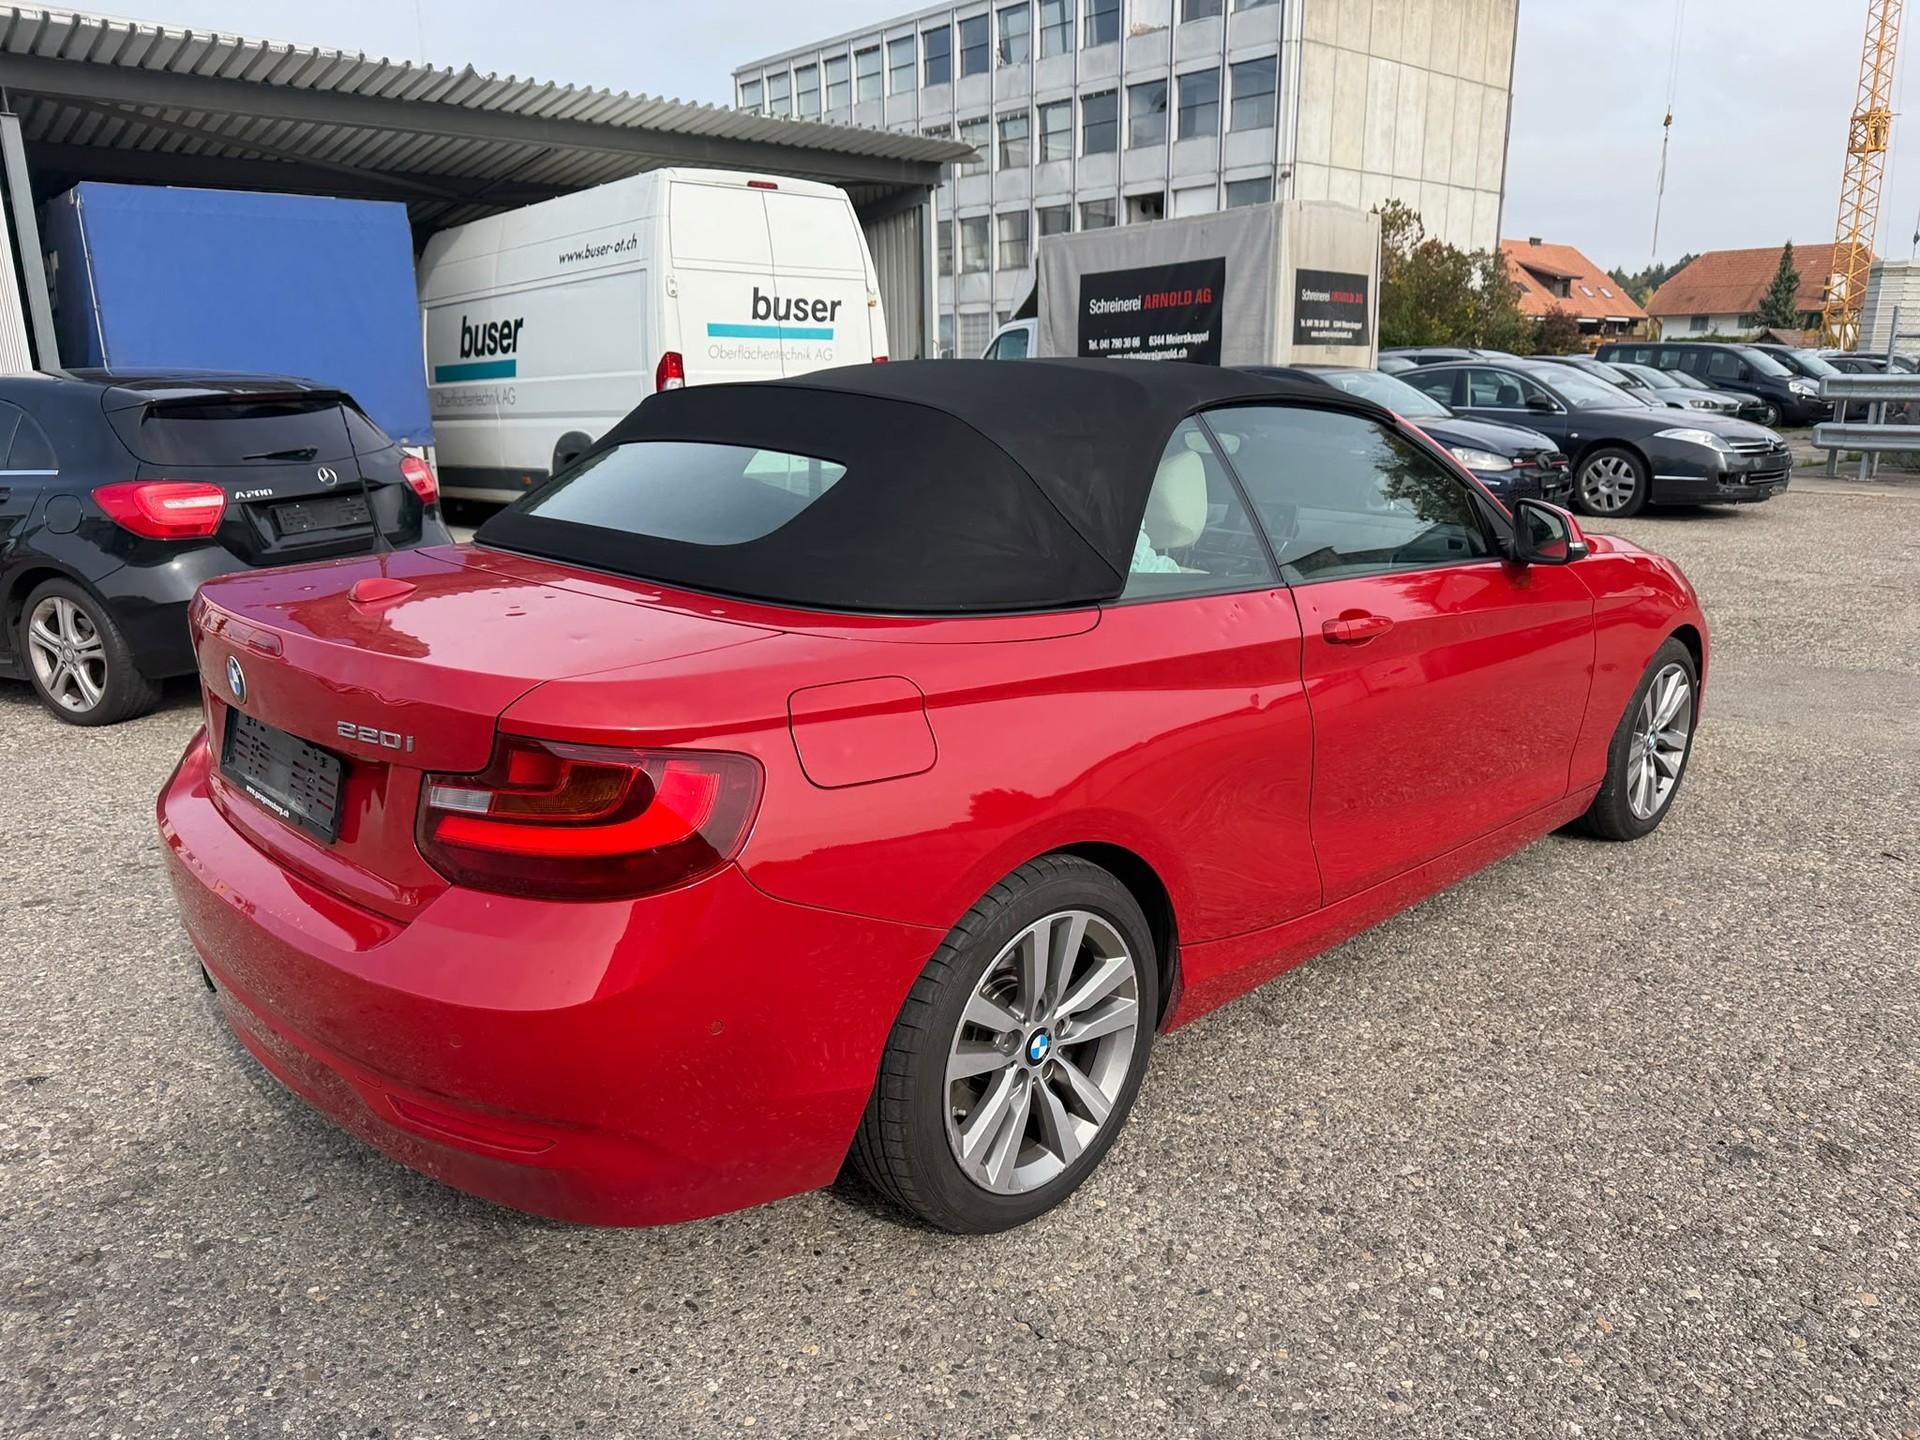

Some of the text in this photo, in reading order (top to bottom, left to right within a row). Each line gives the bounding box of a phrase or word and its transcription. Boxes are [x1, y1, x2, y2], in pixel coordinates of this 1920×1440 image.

[559, 232, 638, 264] www.buser-ot.ch
[752, 286, 842, 322] buser
[1089, 287, 1212, 314] Schreinerei ARNOLD AG
[460, 315, 524, 359] buser
[1123, 336, 1131, 348] 30
[1148, 334, 1165, 346] 6344
[708, 344, 834, 361] Oberflächentechnik AG
[502, 386, 517, 405] AG
[336, 720, 415, 753] 220i
